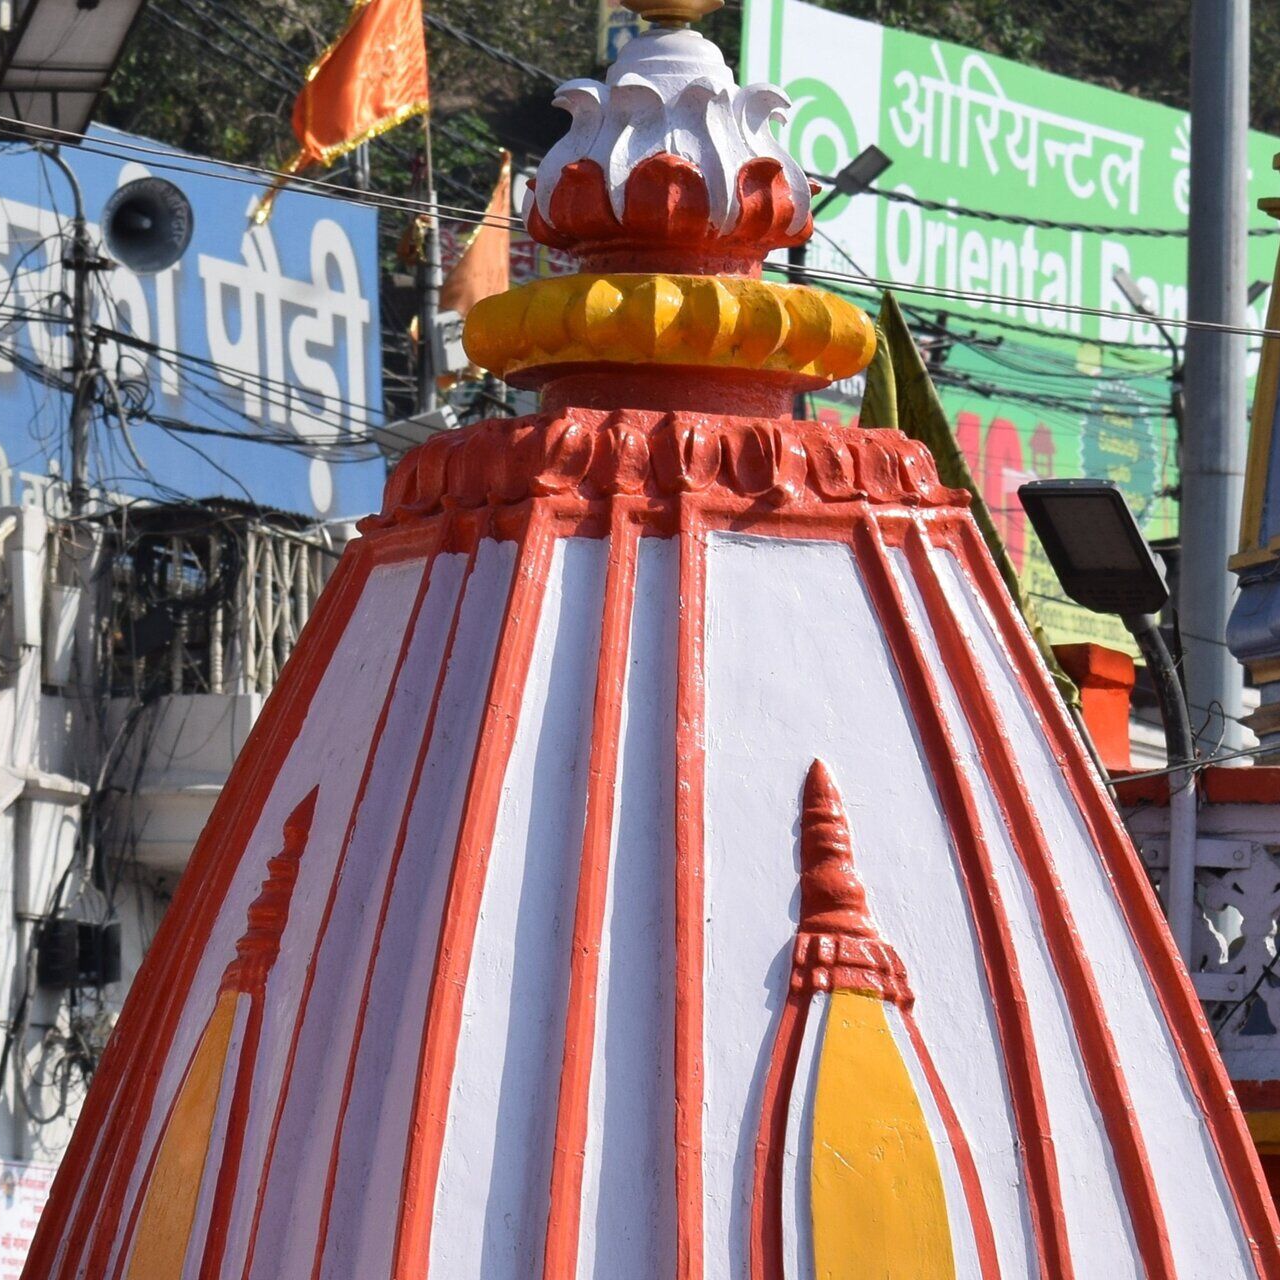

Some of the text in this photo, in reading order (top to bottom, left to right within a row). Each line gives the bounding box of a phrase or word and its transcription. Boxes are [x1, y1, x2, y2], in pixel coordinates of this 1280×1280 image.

[889, 42, 1144, 215] ओरियन्टल
[886, 185, 1082, 336] Oriental
[198, 195, 370, 512] पौड़ी
